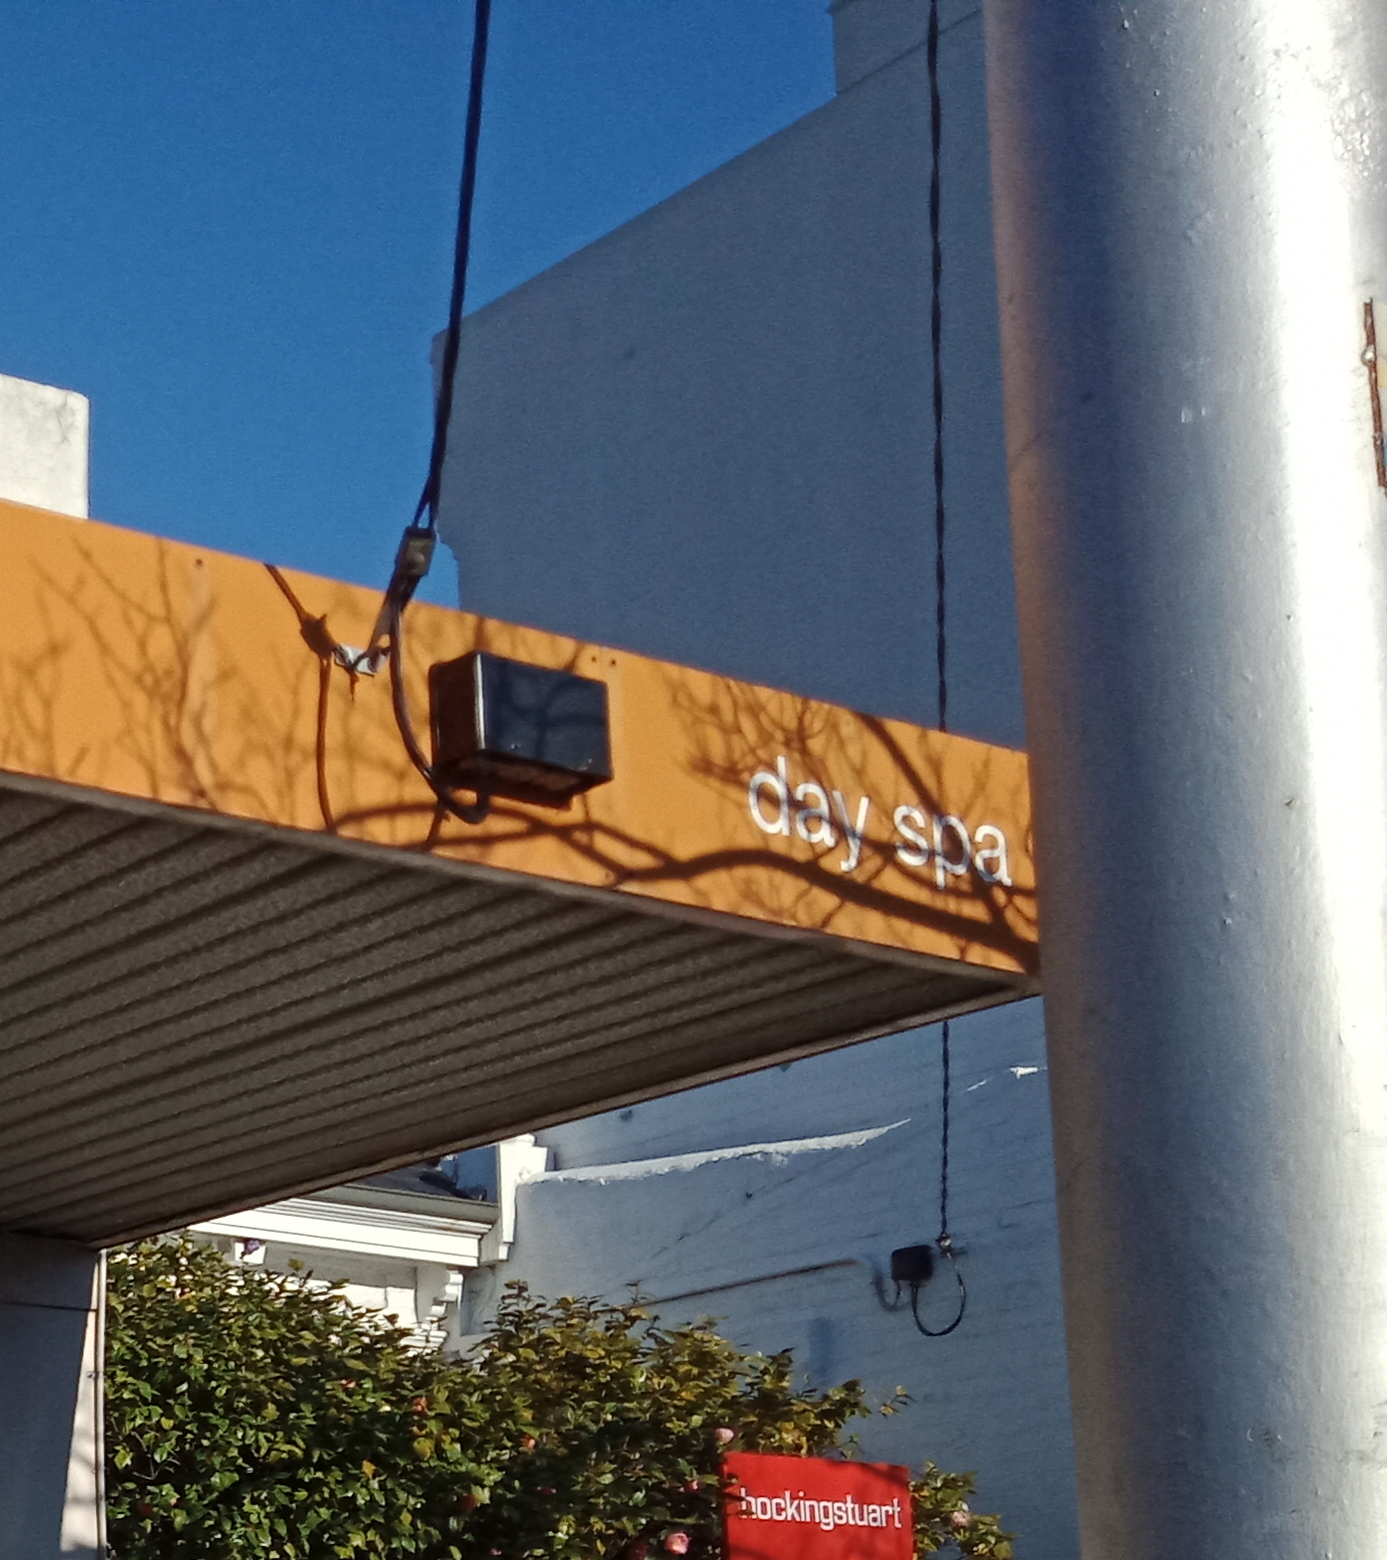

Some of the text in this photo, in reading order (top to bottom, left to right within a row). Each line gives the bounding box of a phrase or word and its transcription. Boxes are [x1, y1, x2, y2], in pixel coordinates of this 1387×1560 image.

[747, 755, 1013, 889] day spa
[739, 1488, 902, 1530] hockingstuart
